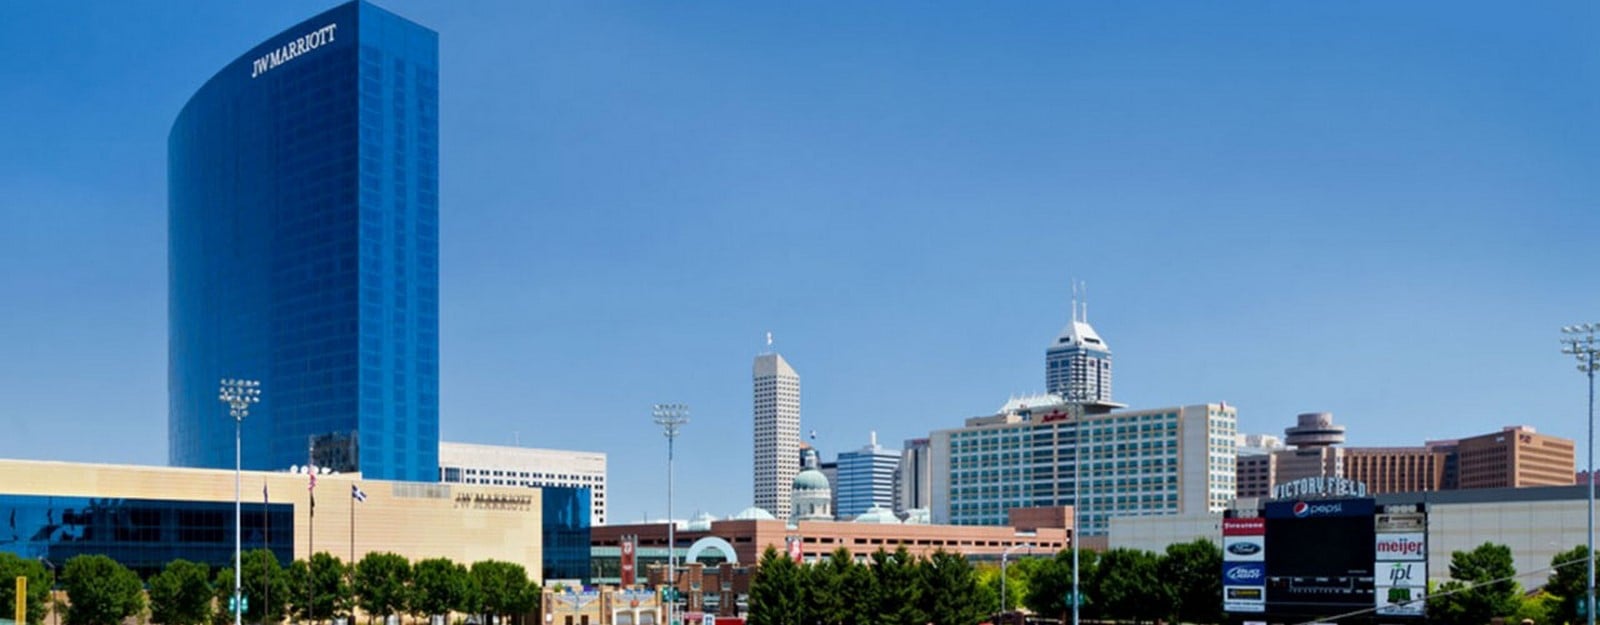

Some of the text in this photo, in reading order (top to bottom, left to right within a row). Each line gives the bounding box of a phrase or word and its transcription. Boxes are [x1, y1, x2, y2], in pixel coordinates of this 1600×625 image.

[251, 23, 337, 79] JW MARRIOTT
[1273, 476, 1366, 499] VICTORY FIELD
[1310, 502, 1342, 514] pepsi
[1377, 538, 1424, 556] meijer
[1389, 563, 1412, 586] ipl
